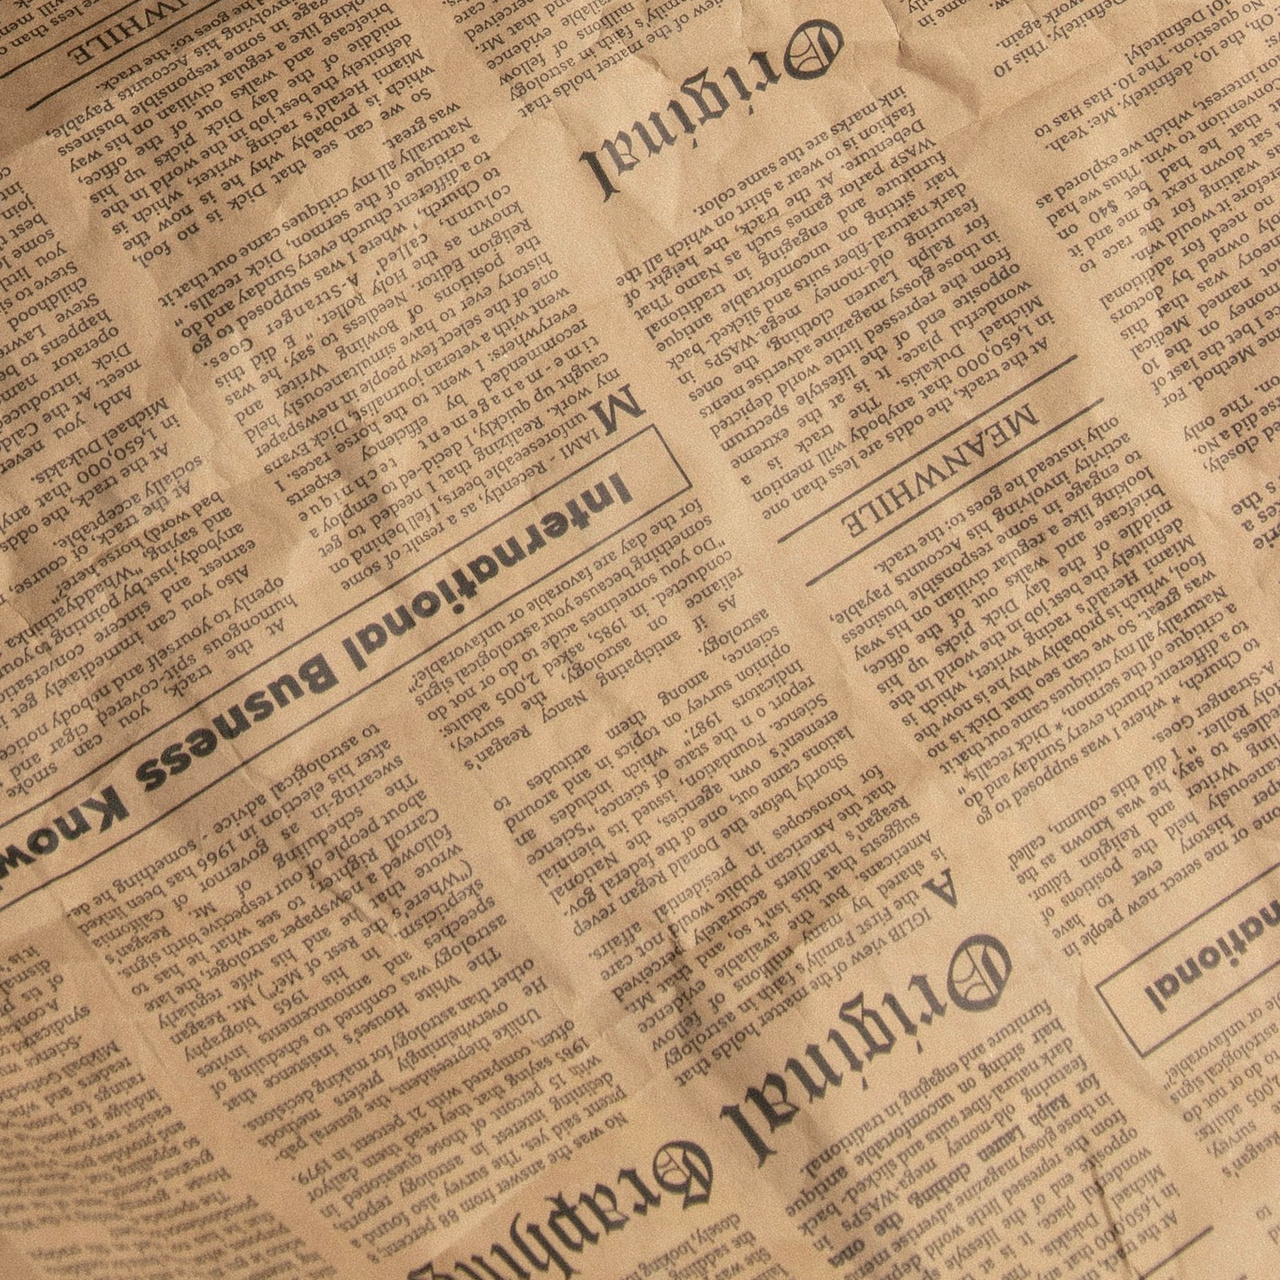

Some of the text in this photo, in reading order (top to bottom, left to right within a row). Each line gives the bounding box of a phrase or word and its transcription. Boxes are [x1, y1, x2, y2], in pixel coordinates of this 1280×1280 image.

[576, 2, 634, 39] millions
[646, 24, 672, 42] the
[673, 13, 689, 32] of
[552, 40, 567, 57] of
[597, 24, 633, 49] faith
[499, 52, 545, 85] fellow
[578, 47, 596, 59] in
[595, 39, 644, 72] matter
[510, 57, 575, 101] astrology
[552, 68, 596, 97] holds
[517, 94, 551, 117] that
[578, 18, 844, 202] Original
[93, 385, 131, 415] And,
[751, 311, 1055, 502] in 1,650,000 that anybody will mention
[52, 411, 86, 439] you
[762, 336, 1046, 519] At the track, the odds are less than one
[841, 402, 1039, 537] MEANWHILE
[347, 471, 635, 672] International
[265, 617, 283, 635] At
[225, 639, 253, 659] the
[163, 664, 212, 697] track,
[117, 699, 151, 728] you
[134, 638, 341, 795] Busness
[72, 734, 102, 756] can
[6, 762, 57, 797] smoke
[718, 931, 1014, 1171] Original
